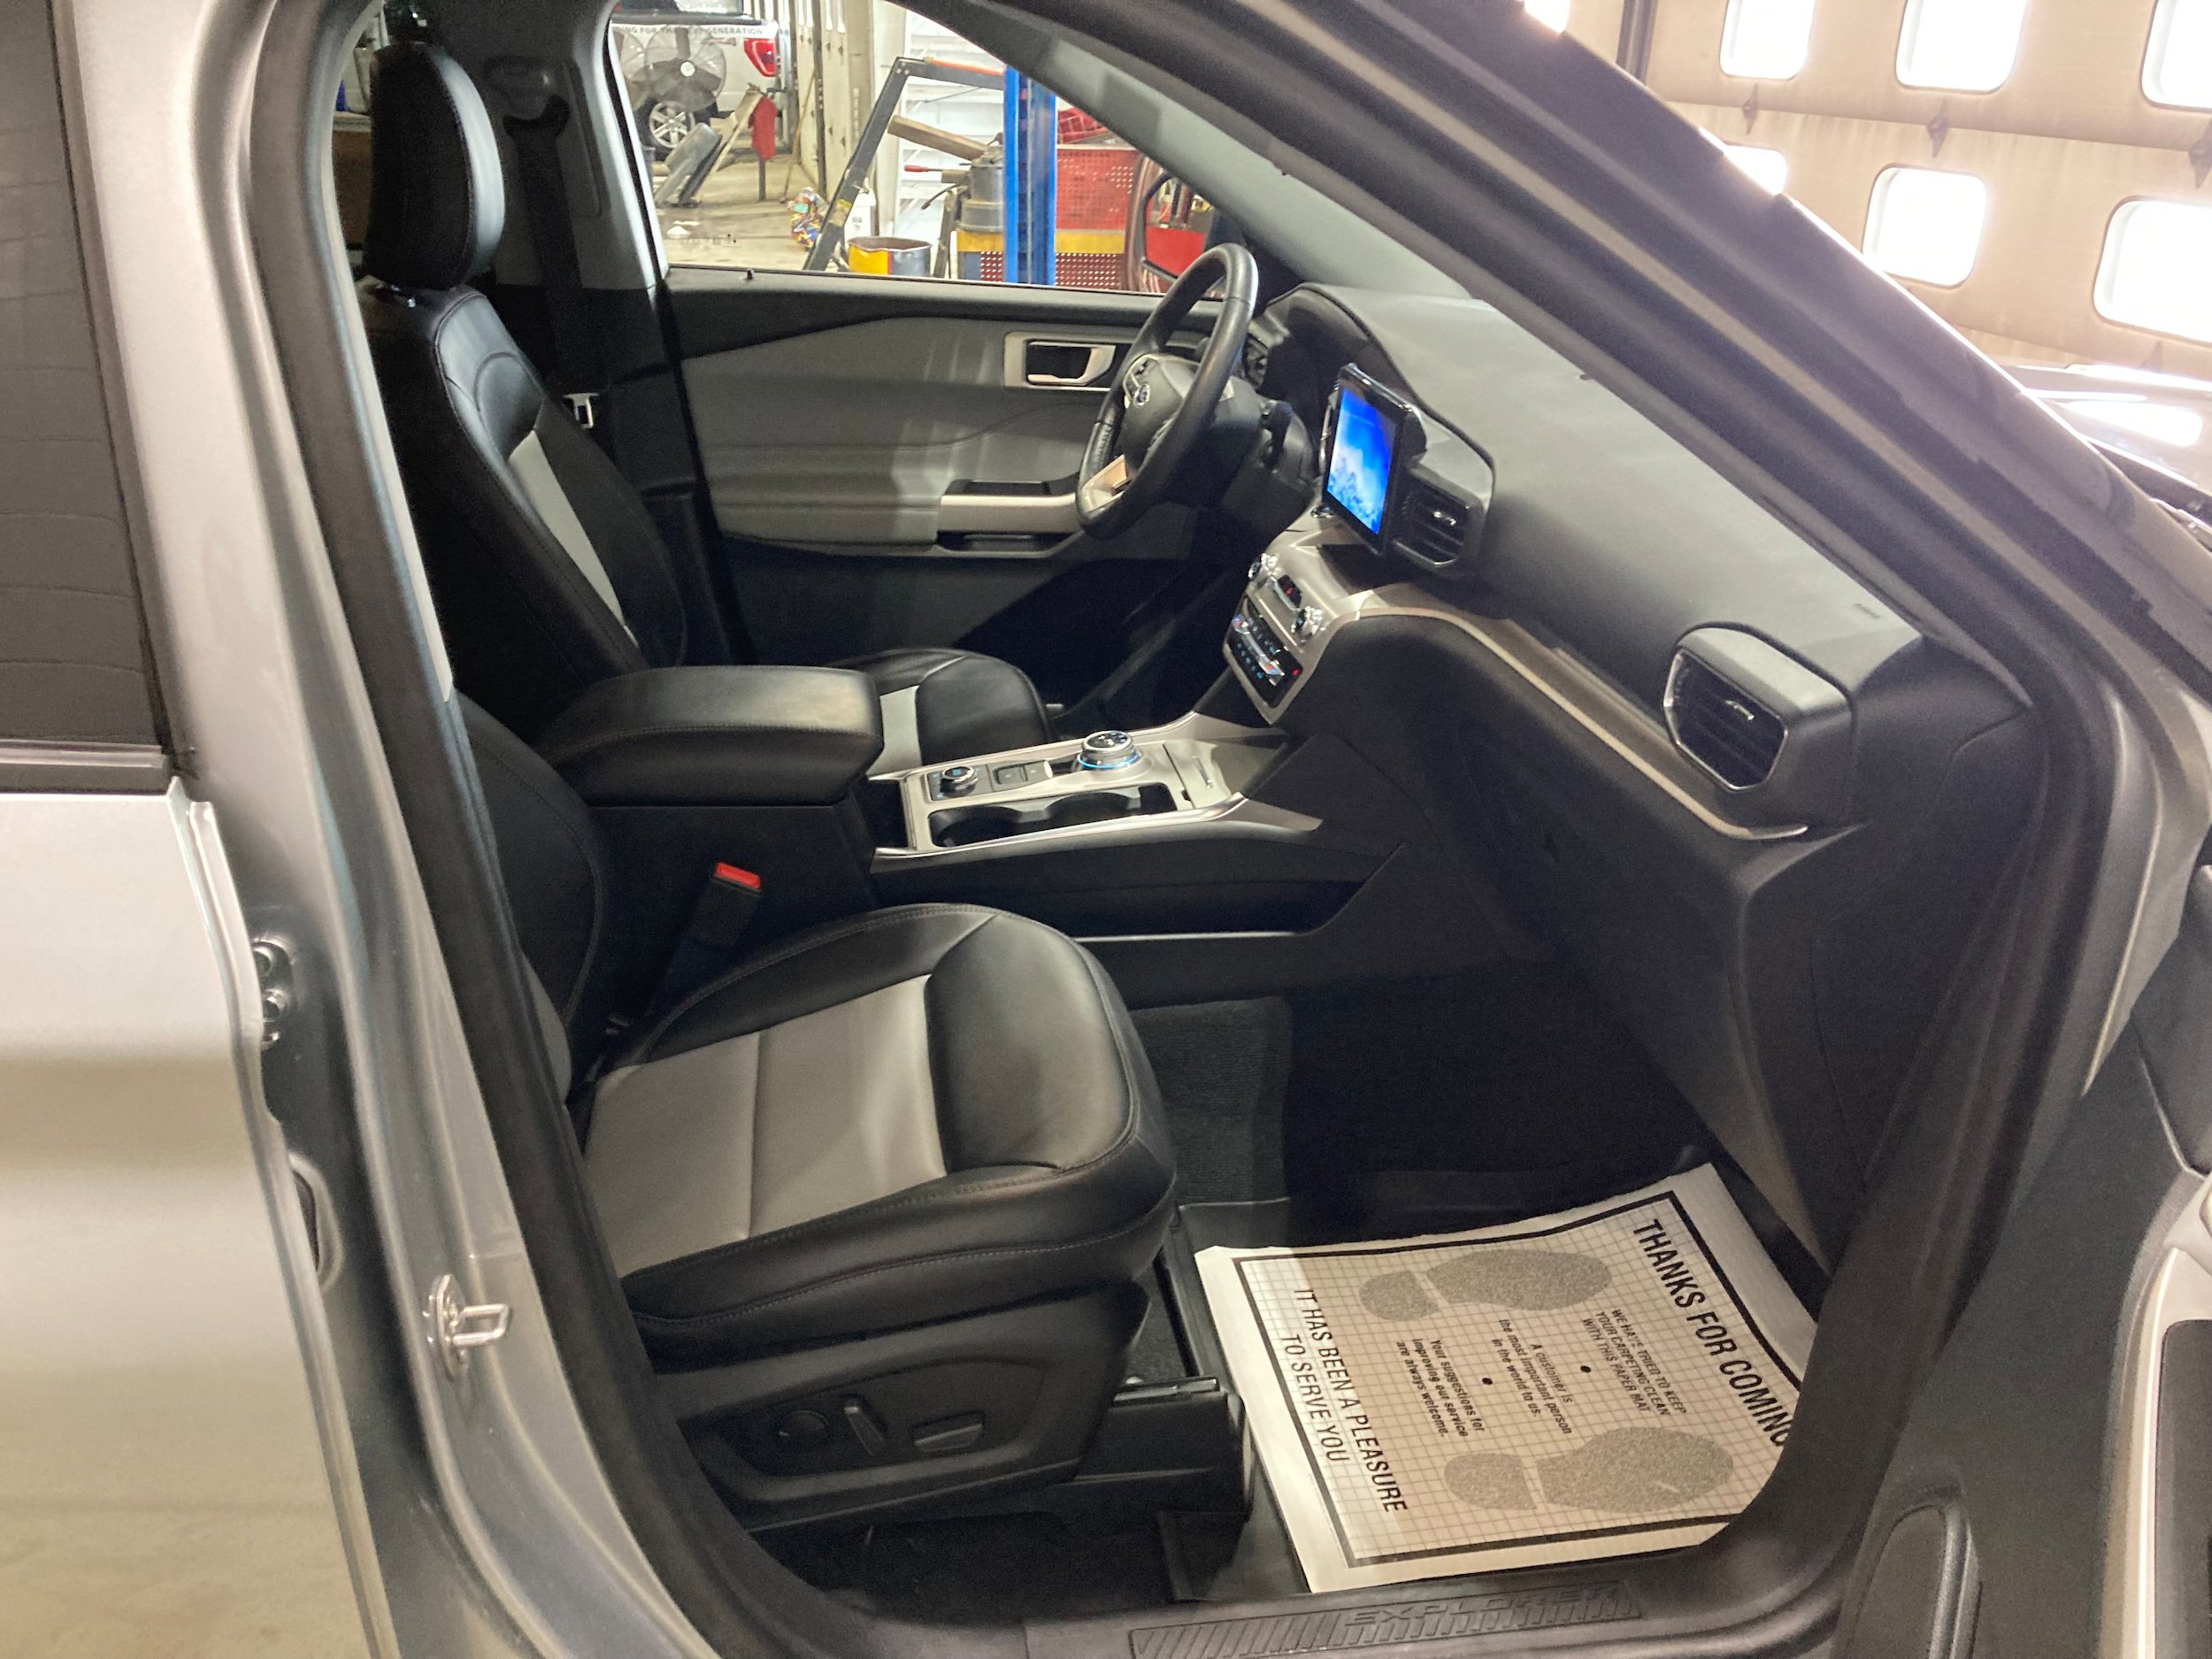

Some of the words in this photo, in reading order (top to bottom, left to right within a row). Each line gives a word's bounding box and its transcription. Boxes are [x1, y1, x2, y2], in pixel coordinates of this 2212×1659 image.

[1294, 1289, 1317, 1303] IT
[1633, 1218, 1706, 1308] THANKS
[1686, 1311, 1738, 1356] FOR
[1281, 1333, 1306, 1356] TO
[1302, 1309, 1333, 1341] HAS
[1611, 1310, 1628, 1324] WE
[1620, 1325, 1644, 1348] HAVE
[1637, 1349, 1661, 1375] TRIED
[1655, 1377, 1671, 1389] TO
[1664, 1390, 1686, 1414] KEEP
[1292, 1363, 1332, 1419] SERVE
[1317, 1347, 1355, 1391] BEEN
[1396, 1341, 1410, 1356] are
[1404, 1359, 1426, 1391] always
[1421, 1392, 1448, 1438] welcome.
[1411, 1338, 1440, 1382] improving
[1435, 1385, 1450, 1400] our
[1444, 1402, 1469, 1437] service
[1430, 1339, 1447, 1359] Your
[1440, 1361, 1476, 1417] suggestions
[1470, 1418, 1485, 1432] for
[1497, 1348, 1511, 1363] the
[1507, 1365, 1530, 1390] world
[1521, 1392, 1533, 1402] to
[1498, 1319, 1513, 1333] the
[1508, 1334, 1528, 1356] most
[1520, 1356, 1555, 1401] important
[1544, 1402, 1572, 1434] person
[1535, 1352, 1567, 1393] customer
[1561, 1394, 1573, 1403] is
[1582, 1317, 1603, 1340] WITH
[1596, 1342, 1617, 1363] THIS
[1610, 1363, 1637, 1392] PAPER
[1630, 1393, 1651, 1412] MAT
[1595, 1311, 1618, 1335] YOUR
[1610, 1336, 1650, 1385] CARPETING
[1643, 1386, 1671, 1416] CLEAN
[1338, 1398, 1361, 1409] A
[1317, 1425, 1350, 1462] YOU
[1346, 1414, 1409, 1512] PLEASURE
